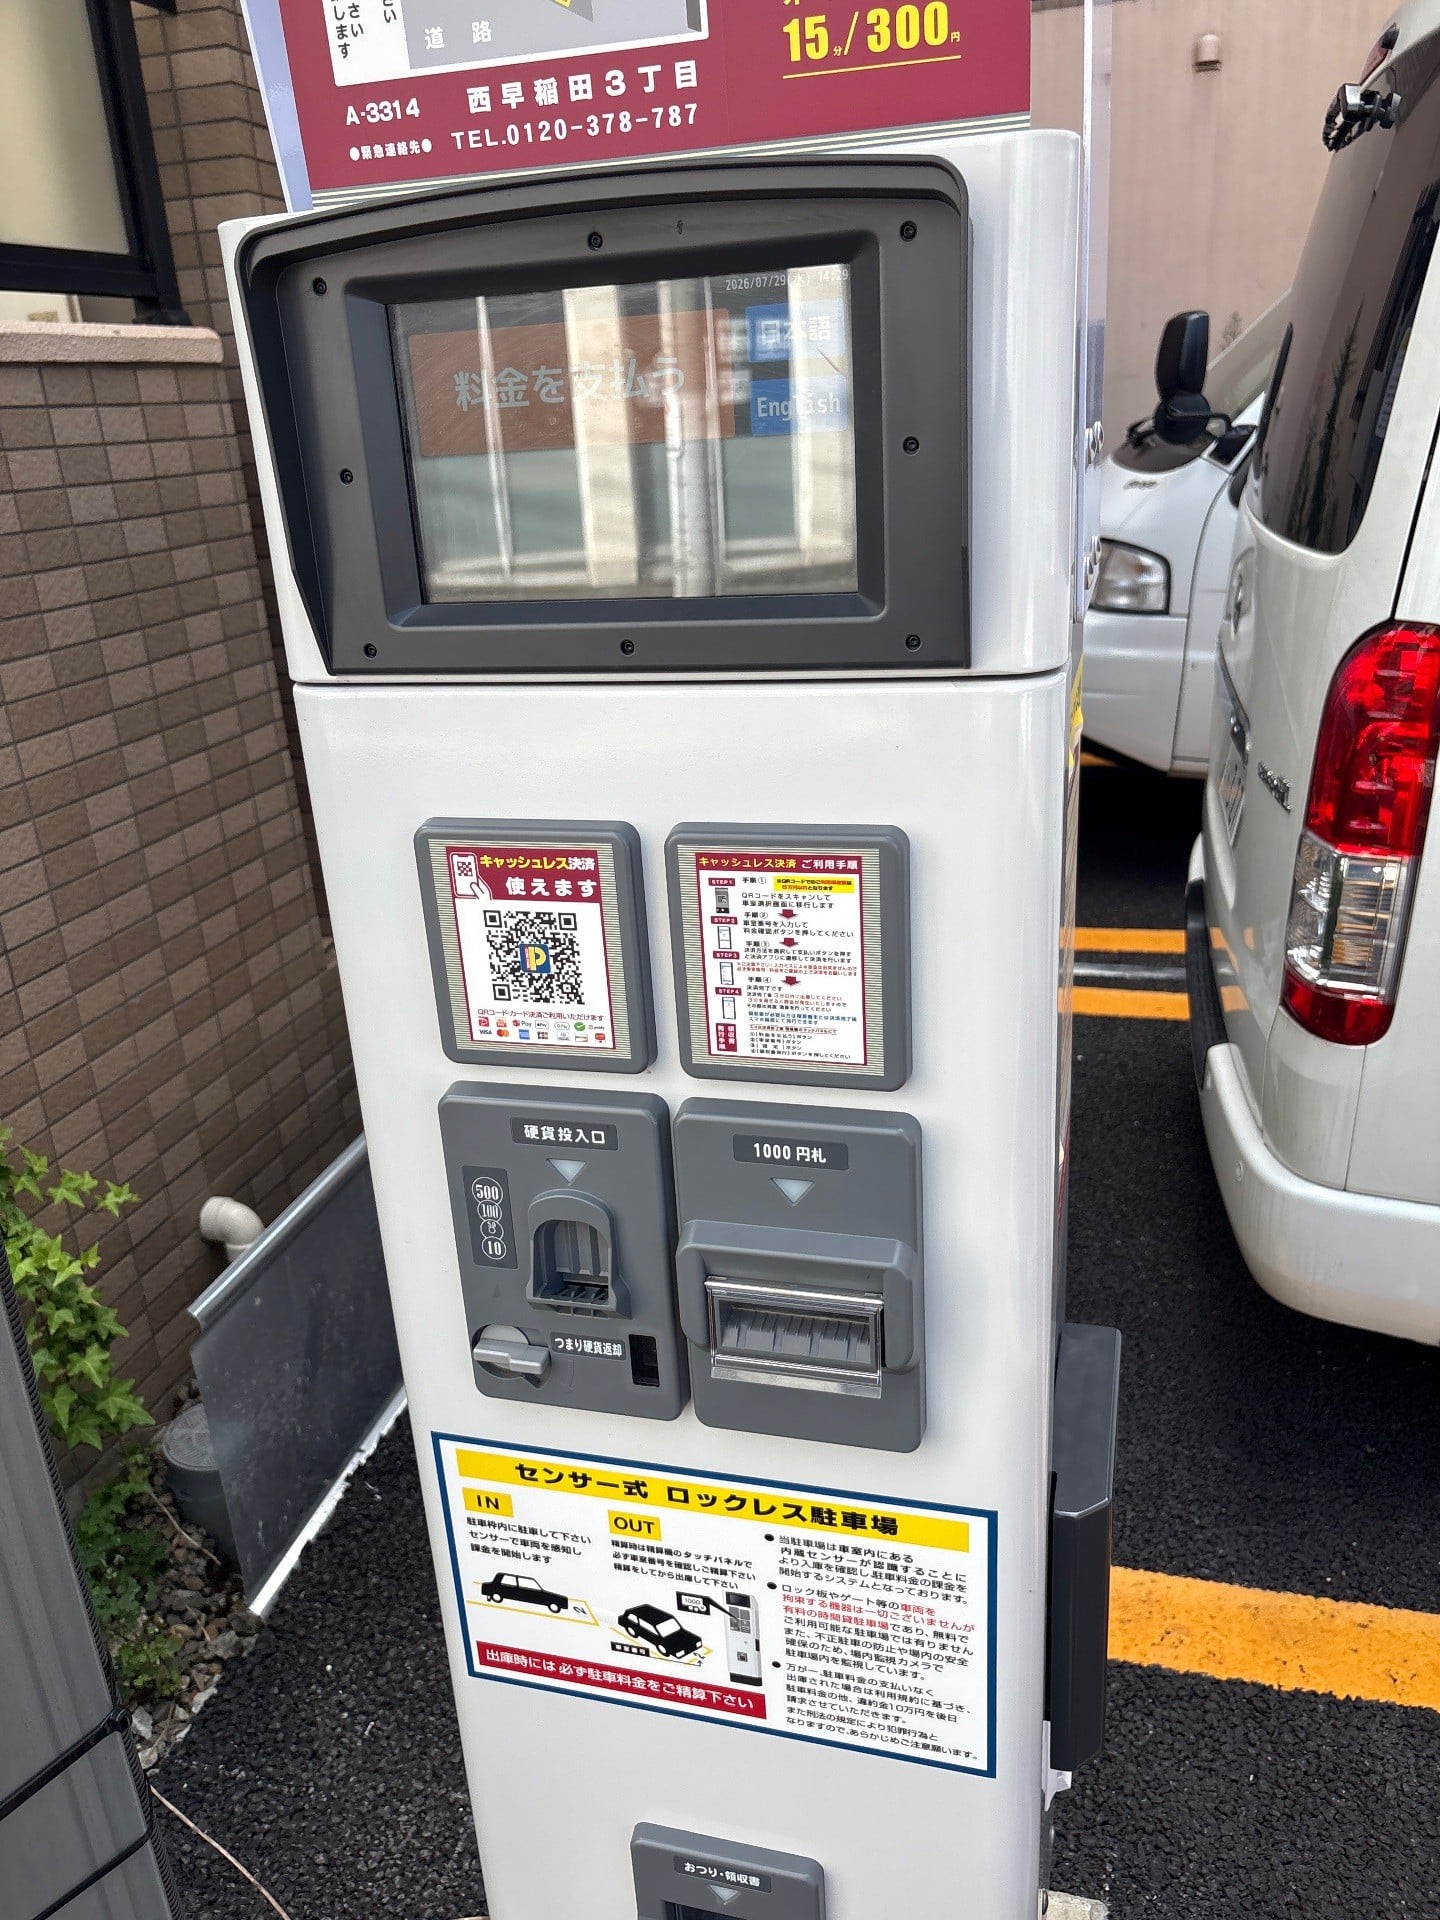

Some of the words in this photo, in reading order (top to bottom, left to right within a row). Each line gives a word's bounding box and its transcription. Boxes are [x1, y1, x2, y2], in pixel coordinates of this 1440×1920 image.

[331, 0, 350, 58] します
[348, 3, 364, 37] さい
[783, 1, 960, 61] 15分/300円
[467, 60, 697, 113] 西早稲田3丁目
[452, 103, 697, 150] TEL.0120-378-787
[819, 269, 849, 283] 14:29
[762, 316, 830, 345] 日本語
[453, 357, 685, 411] 料金を支払う
[758, 392, 840, 421] English
[480, 855, 595, 871] キャッシュレス決済
[699, 857, 797, 869] キャッシュレス決済
[801, 859, 858, 870] ご利用手順
[505, 877, 597, 898] 使えます
[741, 892, 830, 900] QRコードをスキャンして
[524, 1124, 605, 1144] 硬貨投入口
[753, 1142, 791, 1161] 1000
[796, 1146, 827, 1163] 円札
[475, 1184, 499, 1200] 500
[481, 1203, 499, 1218] 100
[487, 1240, 502, 1256] 10
[555, 1338, 623, 1357] つまり硬貨返却
[476, 1494, 499, 1509] IN
[515, 1462, 648, 1500] センサー式
[665, 1484, 898, 1537] ロックレス駐車場
[465, 1516, 591, 1544] 駐車枠内に駐車して下さい
[613, 1515, 655, 1534] OUT
[468, 1530, 582, 1556] センサーで車両を感知し
[470, 1542, 552, 1564] 課金を開始します
[778, 1535, 913, 1563] 当駐車場は車室内にある
[613, 1562, 738, 1589] 精算をしてから出庫して下さい
[780, 1545, 966, 1582] 内蔵センサーが認識することに
[779, 1566, 967, 1604] 開始するシステムとなっております。
[782, 1583, 935, 1617] ロック板やゲート等の車両を
[782, 1593, 974, 1633] 拘束する機器は一切ございませんが
[783, 1604, 968, 1643] 有料の時間貸駐車場であり、無料で
[783, 1615, 973, 1656] ご利用可能な駐車場では有りません
[784, 1627, 968, 1666] また、不正駐車の防止や場内の安全
[785, 1637, 943, 1672] 確保のため、場内監視カメラで
[785, 1647, 924, 1680] 駐車場内を監視しています。
[485, 1647, 558, 1674] 出庫時には
[558, 1661, 754, 1711] 必ず駐車料金をご精算下さい
[786, 1673, 970, 1714] 出庫された場合は利用規約に基づき、
[786, 1694, 906, 1724] 請求させていただきます。
[787, 1705, 938, 1741] また刑法の規定により犯罪行為と
[684, 1861, 760, 1887] おつり・領収書
